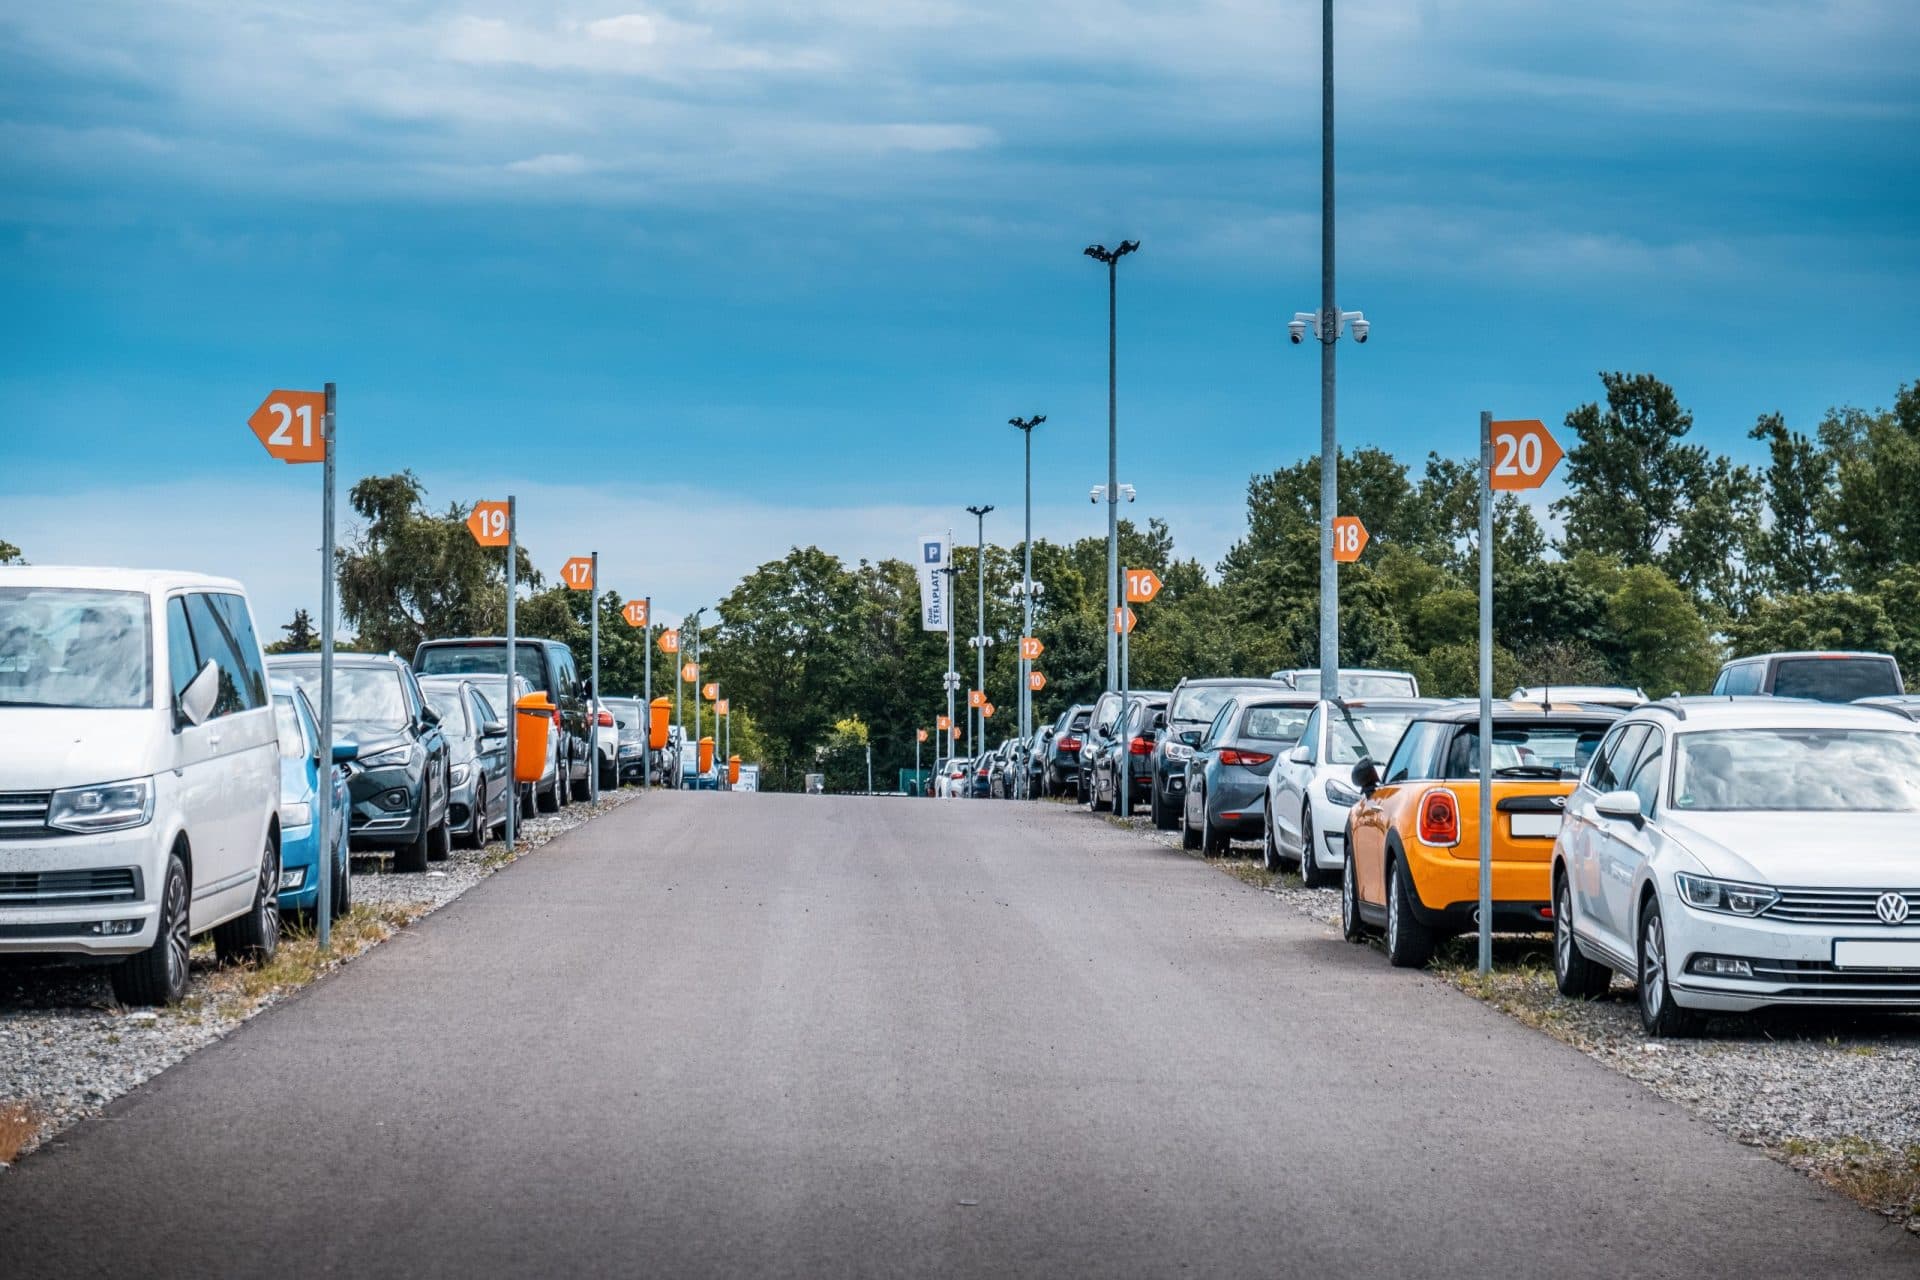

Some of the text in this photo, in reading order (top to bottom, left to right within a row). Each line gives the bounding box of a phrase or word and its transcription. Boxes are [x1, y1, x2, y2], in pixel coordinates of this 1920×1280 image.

[268, 402, 312, 447] 21
[1496, 432, 1542, 476] 20
[479, 510, 505, 537] 19
[1336, 524, 1359, 552] 18
[929, 547, 938, 559] P
[569, 563, 590, 584] 17
[1130, 575, 1152, 596] 16
[629, 605, 645, 621] 15
[665, 634, 677, 649] 13
[1024, 641, 1038, 655] 12
[686, 667, 695, 679] 11
[1030, 674, 1040, 687] 10
[708, 686, 714, 697] 9
[973, 693, 979, 704] 8
[985, 704, 991, 714] 6
[1877, 893, 1908, 922] VW
